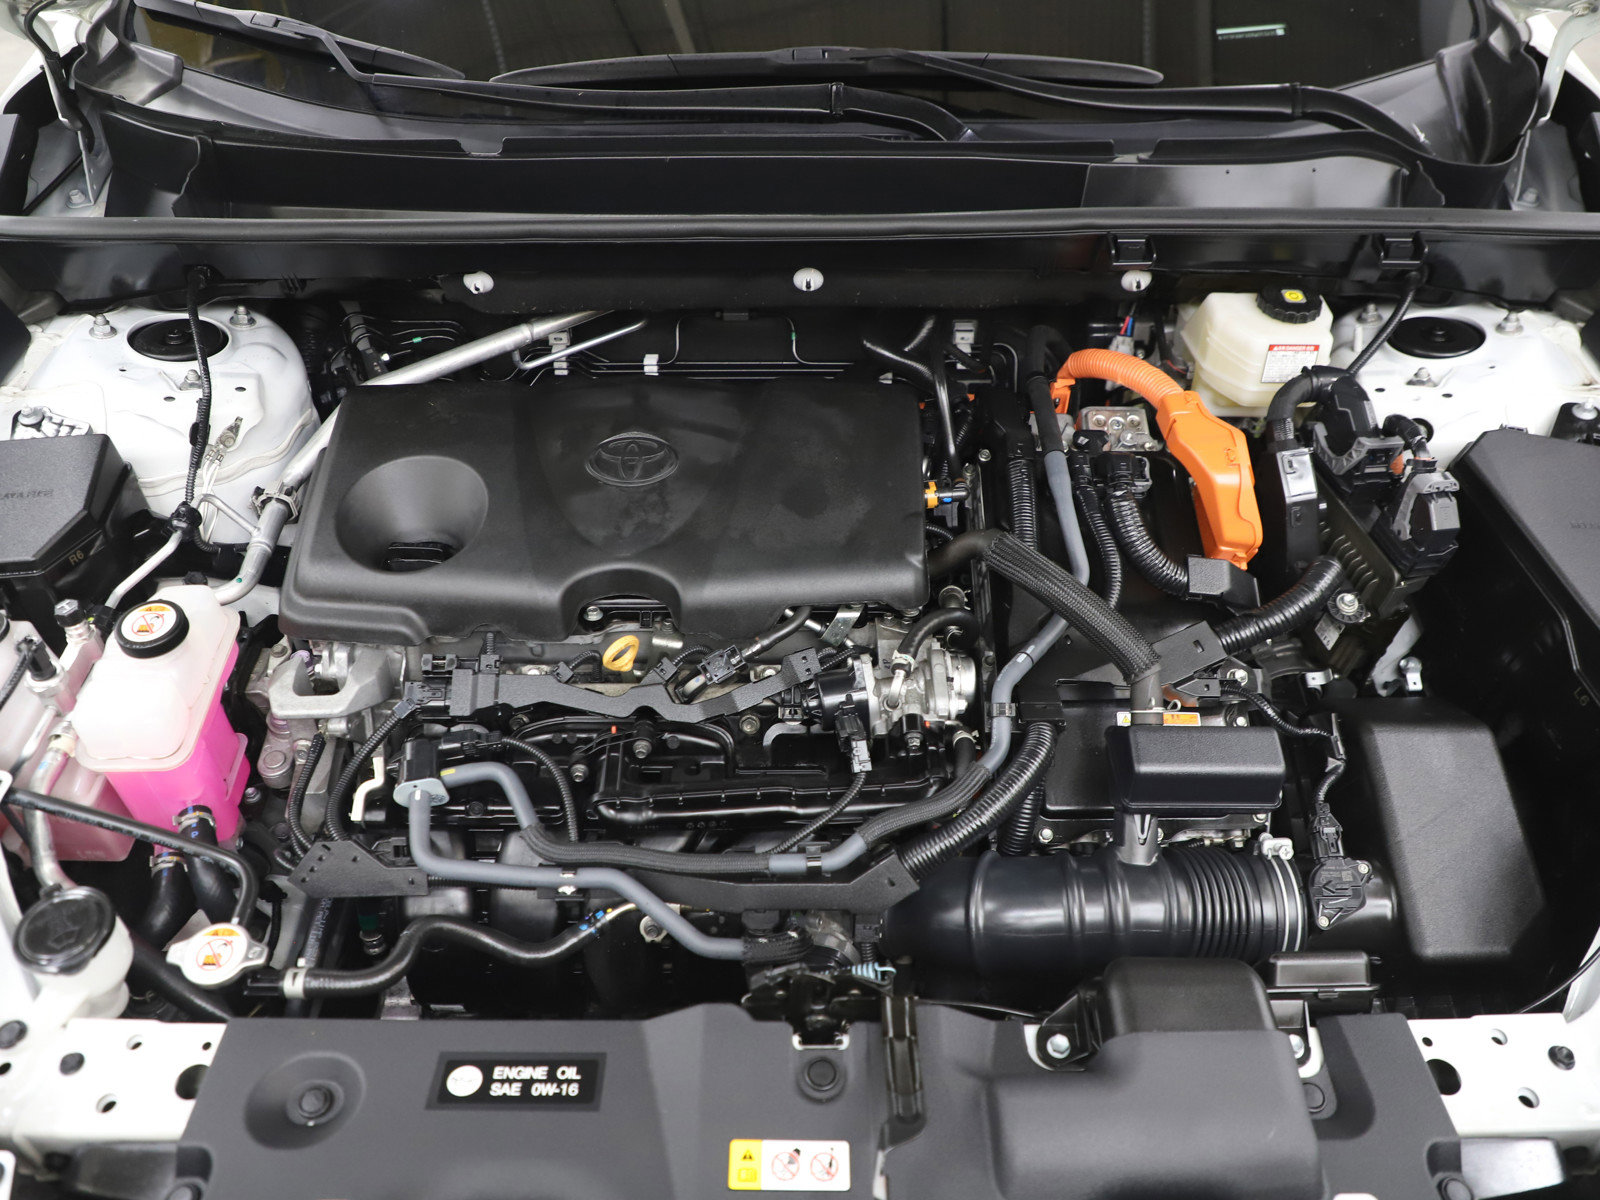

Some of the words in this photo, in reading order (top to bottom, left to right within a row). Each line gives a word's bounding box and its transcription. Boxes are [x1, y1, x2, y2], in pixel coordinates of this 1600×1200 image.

[69, 550, 84, 565] R6
[1574, 687, 1589, 705] L6
[492, 1066, 549, 1080] ENGINE
[556, 1066, 582, 1080] OIL
[489, 1082, 522, 1096] SAE
[531, 1082, 580, 1096] 0W-16
